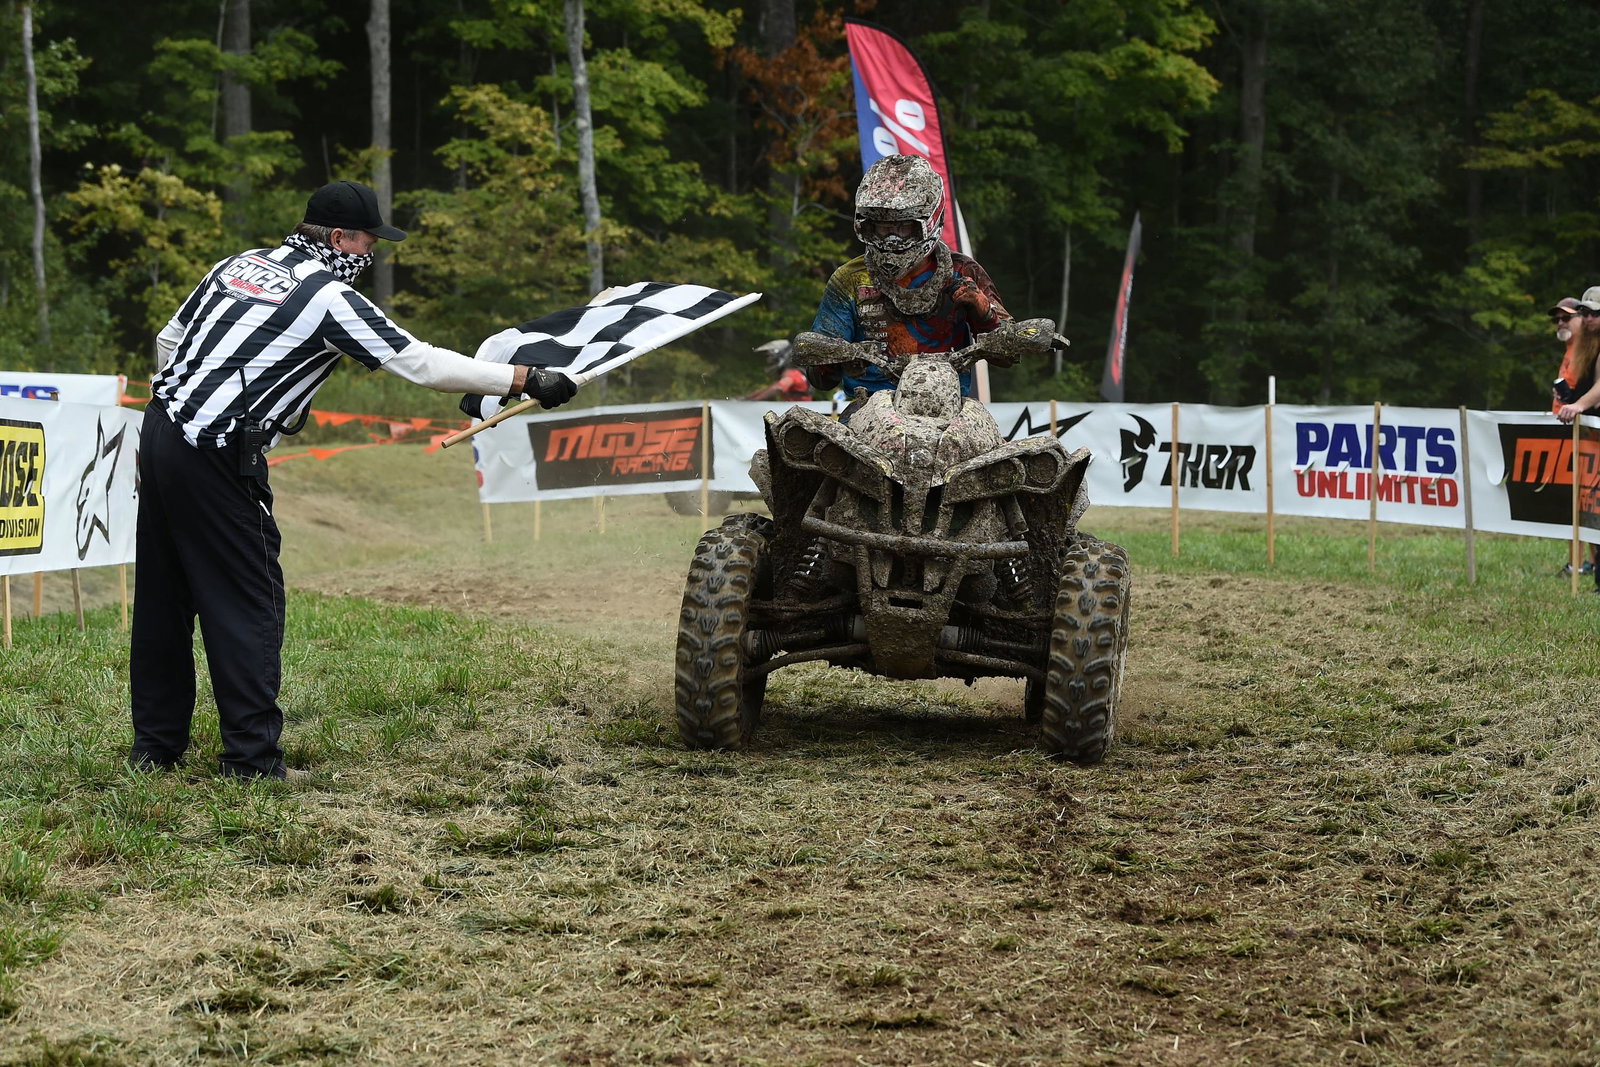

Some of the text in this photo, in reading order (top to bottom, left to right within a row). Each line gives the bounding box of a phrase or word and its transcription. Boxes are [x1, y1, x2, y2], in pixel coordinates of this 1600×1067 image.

[223, 260, 294, 294] GNCC
[229, 277, 265, 295] RACING
[544, 417, 703, 462] MOOSE
[1295, 422, 1457, 475] PARTS
[611, 452, 690, 475] RACING
[1158, 441, 1257, 491] THOR
[1294, 469, 1458, 508] UNLIMITED
